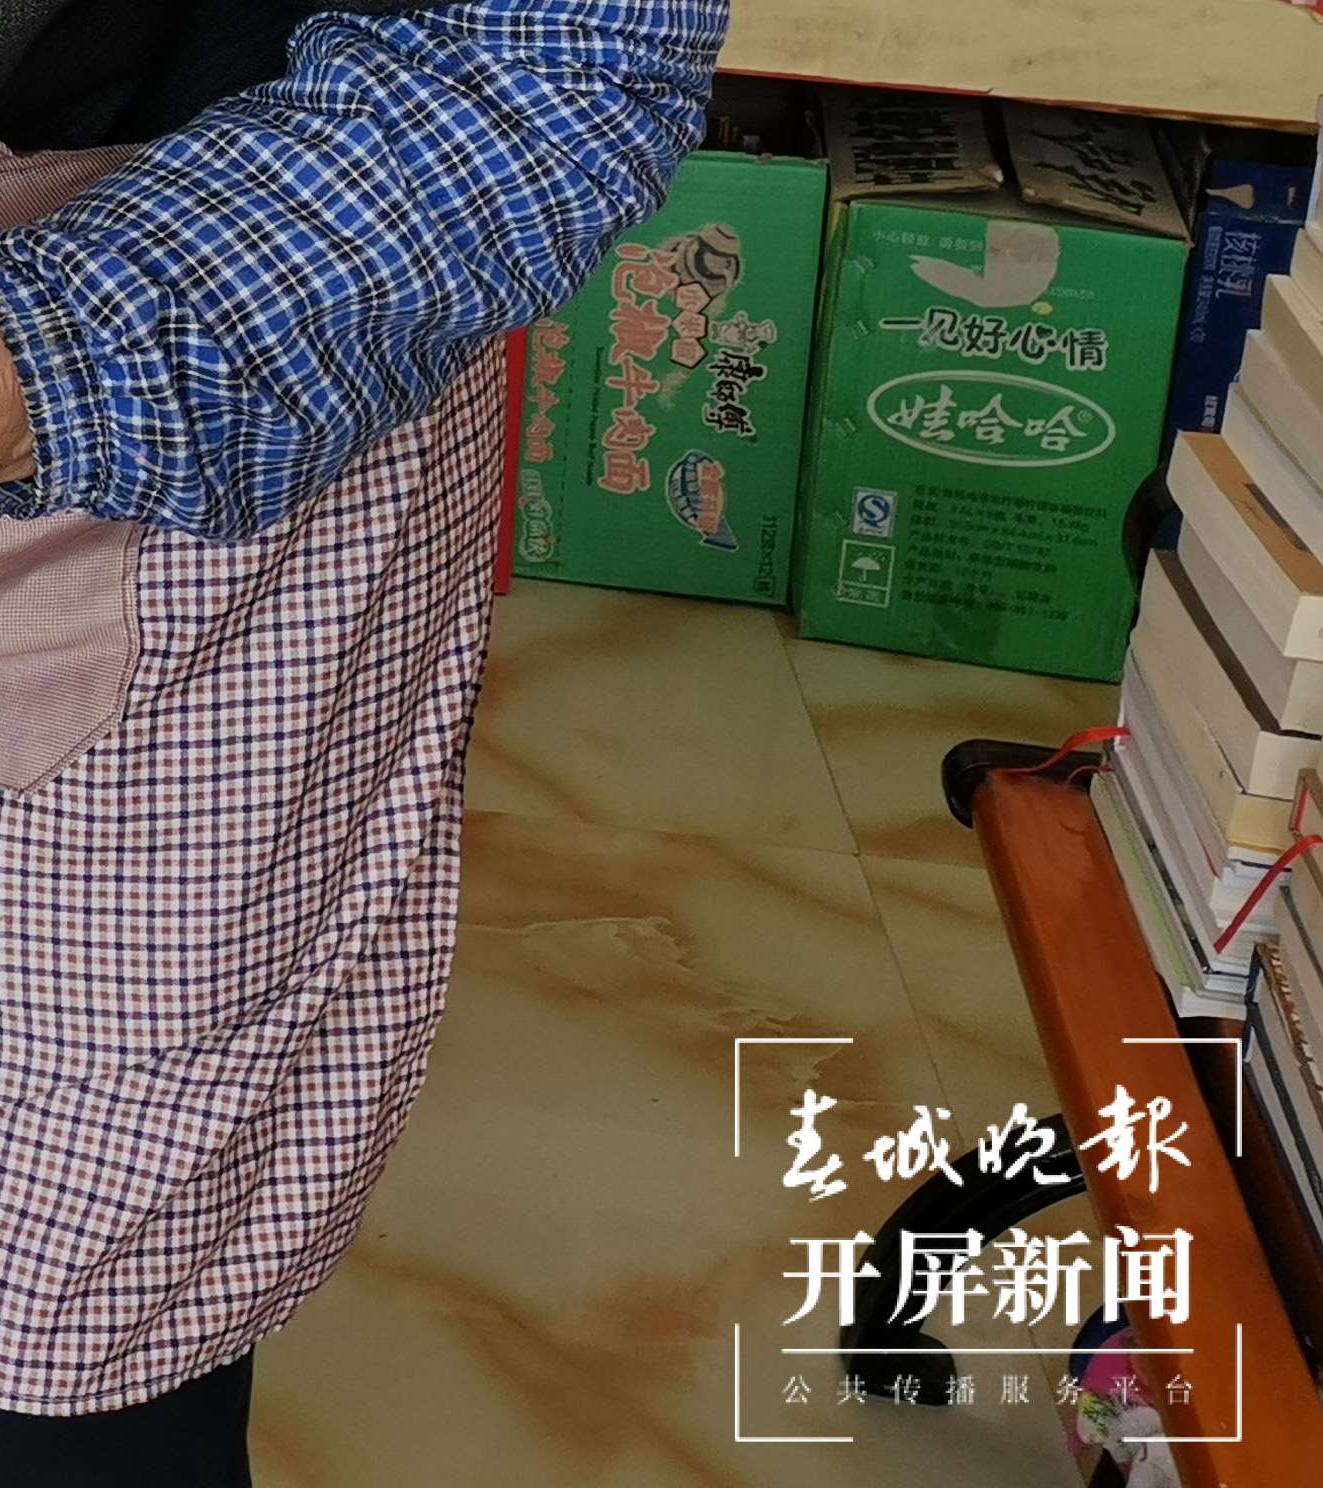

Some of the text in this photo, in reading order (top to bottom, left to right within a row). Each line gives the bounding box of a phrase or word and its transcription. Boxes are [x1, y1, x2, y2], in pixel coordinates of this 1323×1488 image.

[1214, 230, 1261, 299] 核桃乳
[880, 306, 1108, 371] 一见好心情
[887, 383, 1088, 452] 娃哈哈
